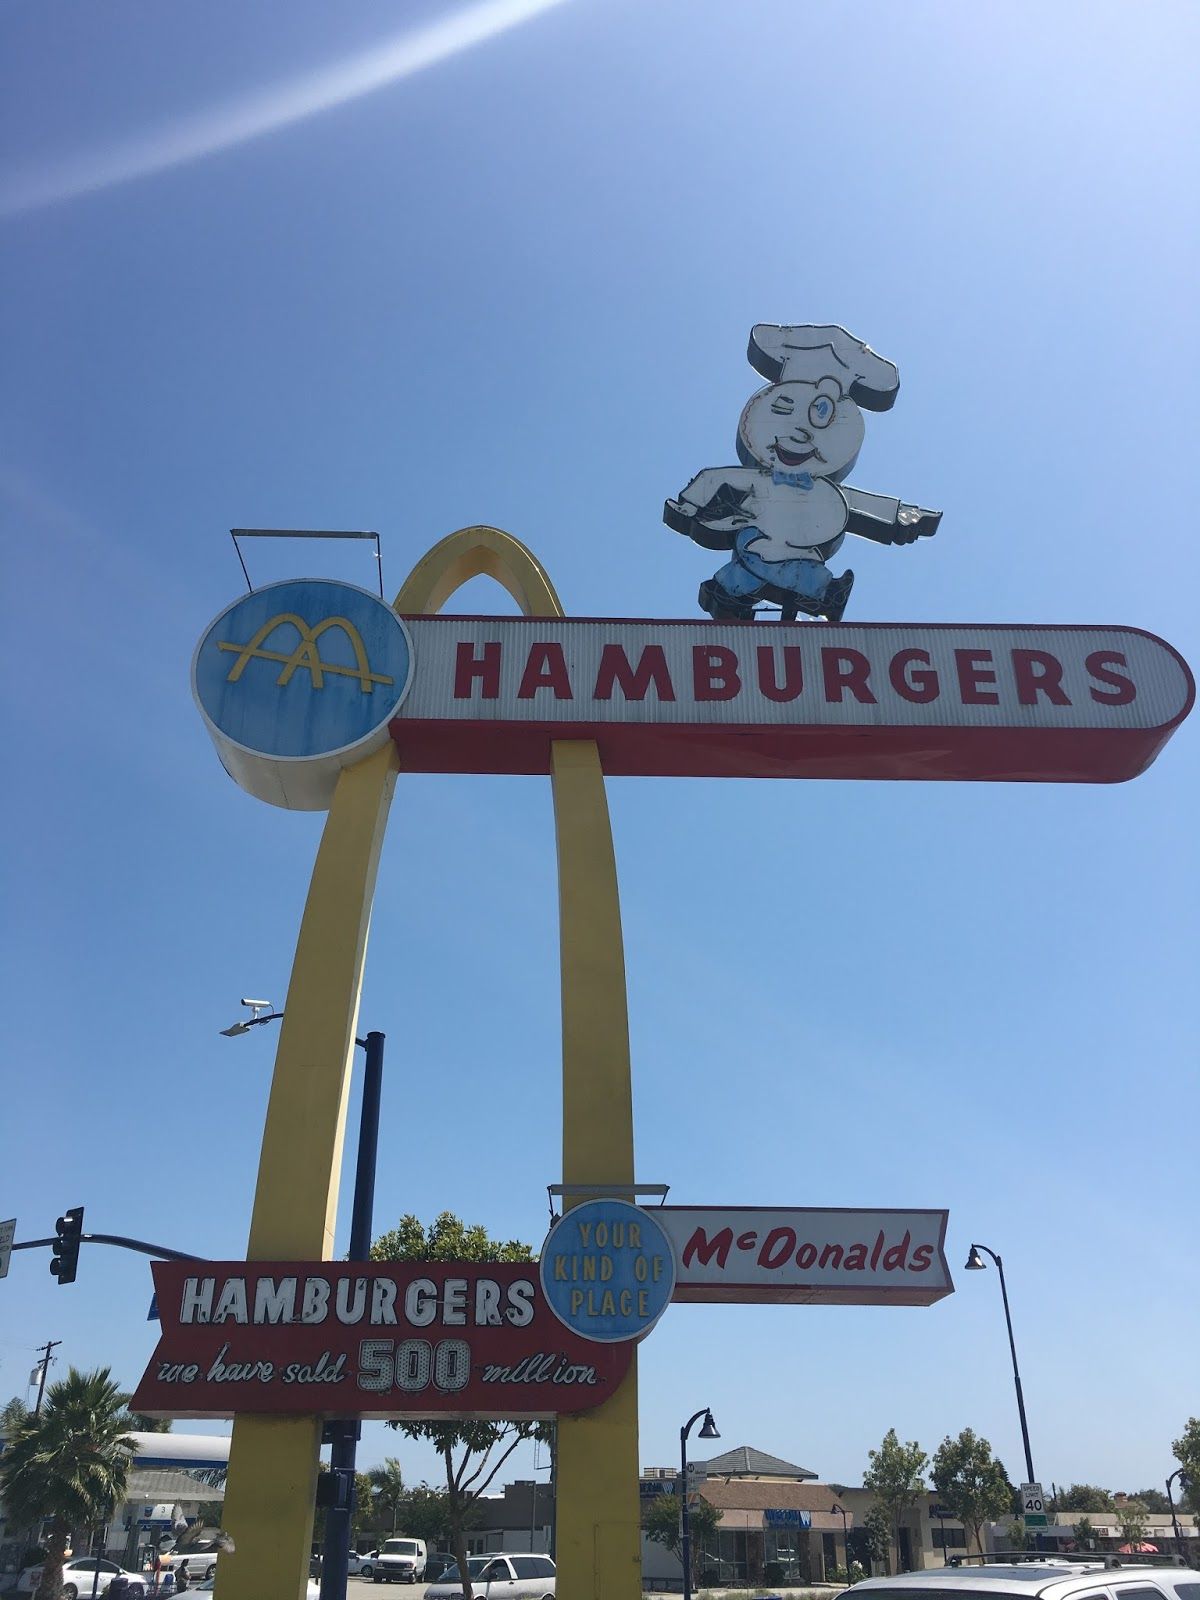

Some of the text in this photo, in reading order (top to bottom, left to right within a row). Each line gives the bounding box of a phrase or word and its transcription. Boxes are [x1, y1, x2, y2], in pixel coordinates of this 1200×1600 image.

[453, 642, 1137, 707] HAMBURGERS
[578, 1222, 642, 1249] YOUR
[682, 1226, 934, 1272] McDonalds
[554, 1254, 664, 1282] KIND OF
[179, 1277, 536, 1327] HAMBURGERS
[570, 1288, 650, 1317] PLACE
[157, 1338, 598, 1392] we have sold 500 million
[1026, 1500, 1042, 1511] 40
